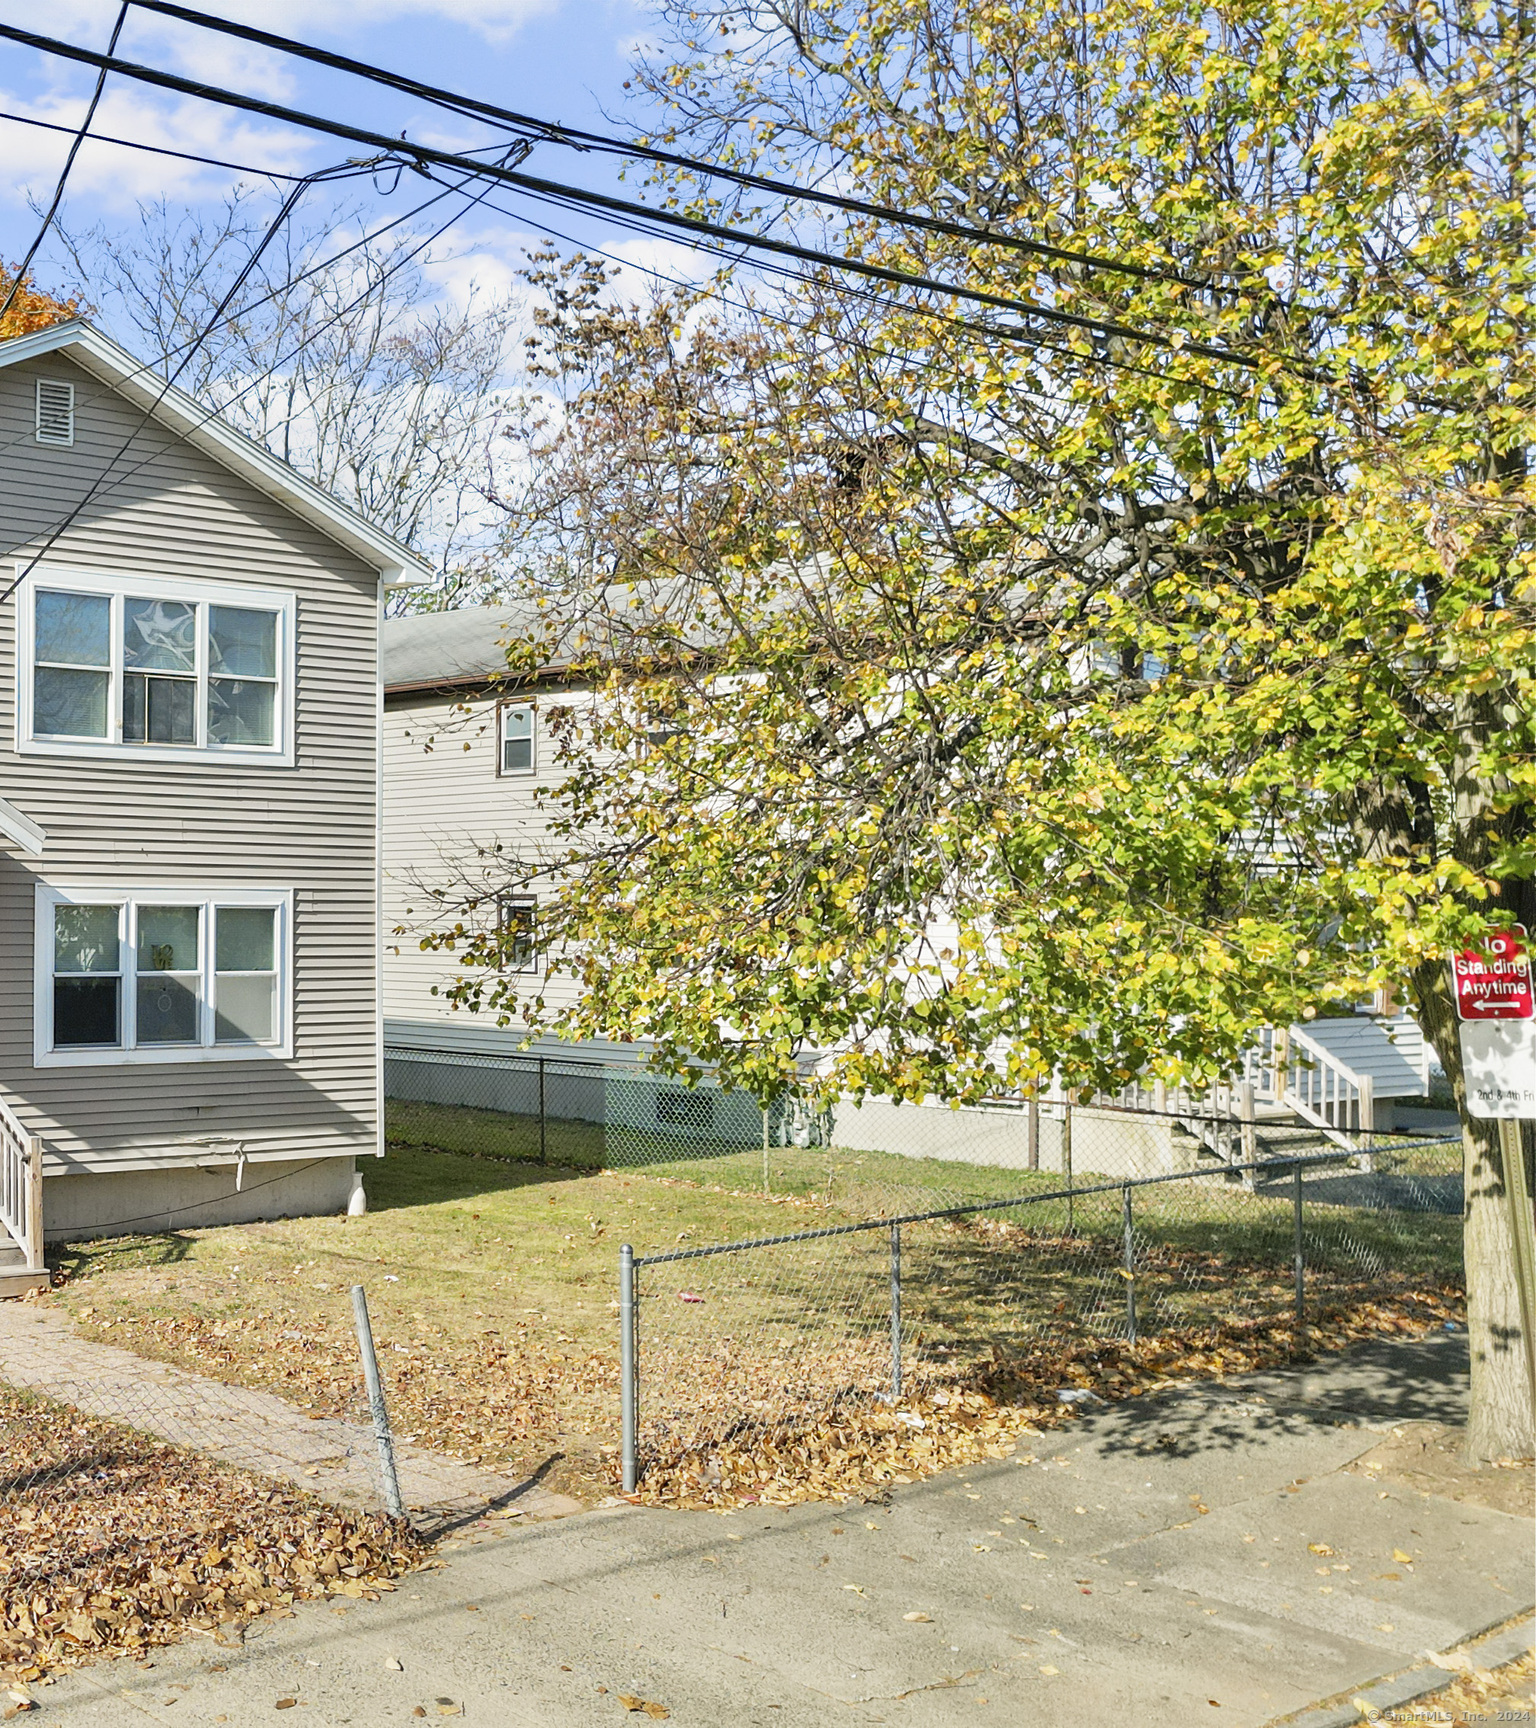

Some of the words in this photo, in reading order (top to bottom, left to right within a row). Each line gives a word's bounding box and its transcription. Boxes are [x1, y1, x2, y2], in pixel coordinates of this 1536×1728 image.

[1457, 958, 1527, 977] Standing
[1462, 979, 1527, 999] Anytime
[1477, 1088, 1494, 1101] 2nd
[1496, 1088, 1503, 1101] &
[1506, 1089, 1521, 1101] 4th
